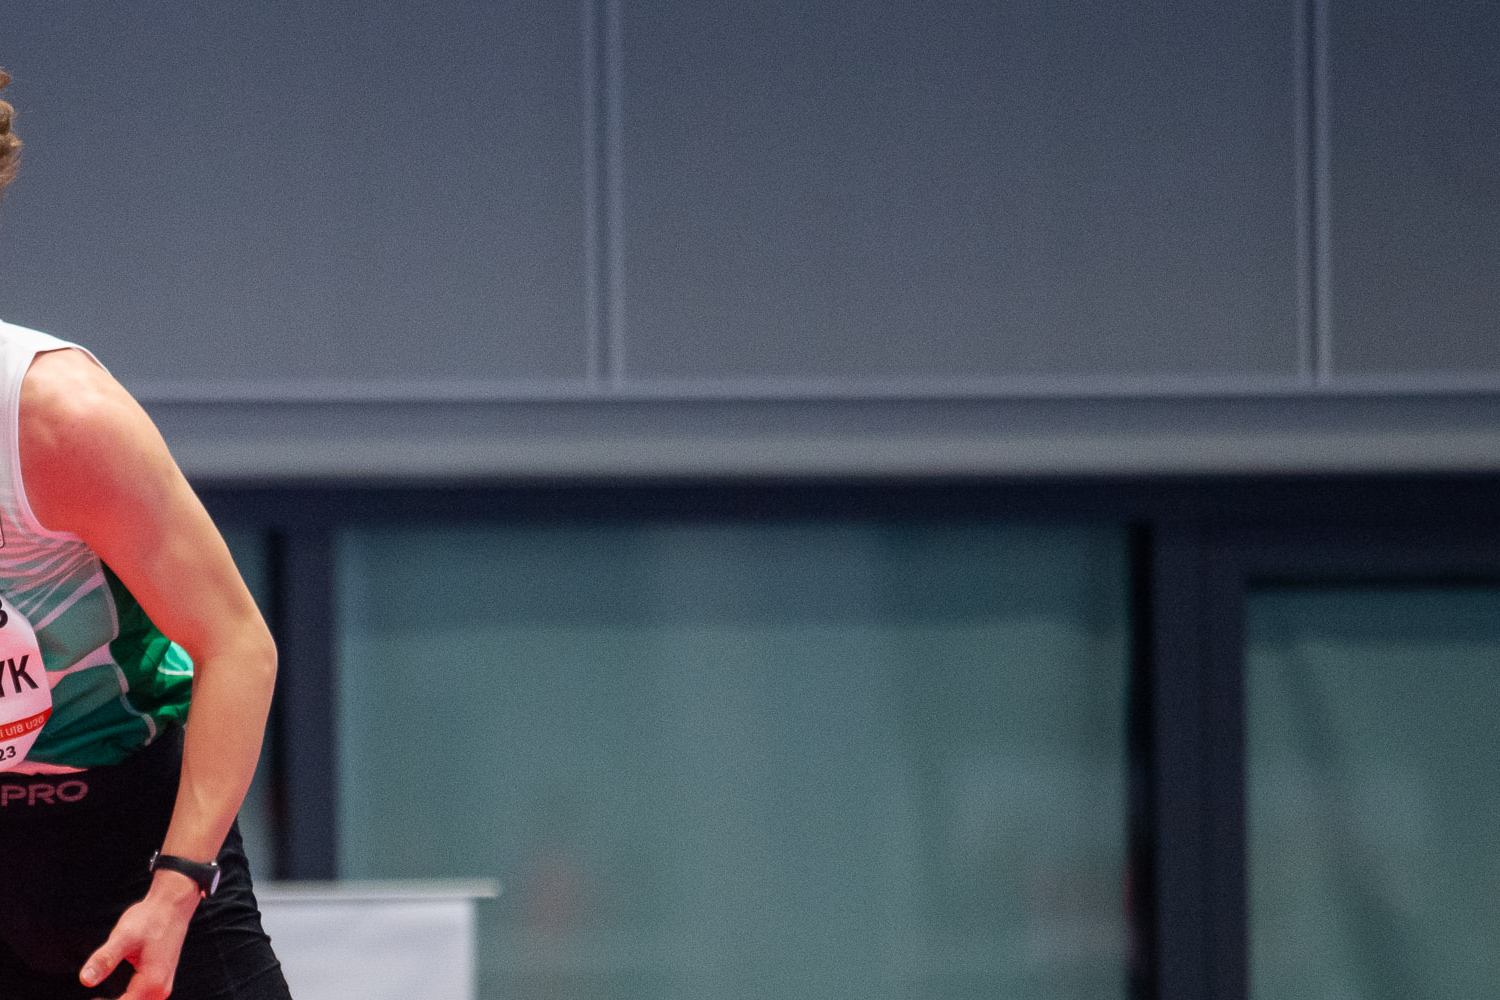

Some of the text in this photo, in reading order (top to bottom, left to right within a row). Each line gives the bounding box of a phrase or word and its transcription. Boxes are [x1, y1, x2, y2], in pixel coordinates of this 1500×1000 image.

[5, 724, 24, 736] U18
[26, 715, 44, 730] U20
[1, 780, 88, 806] PRO
